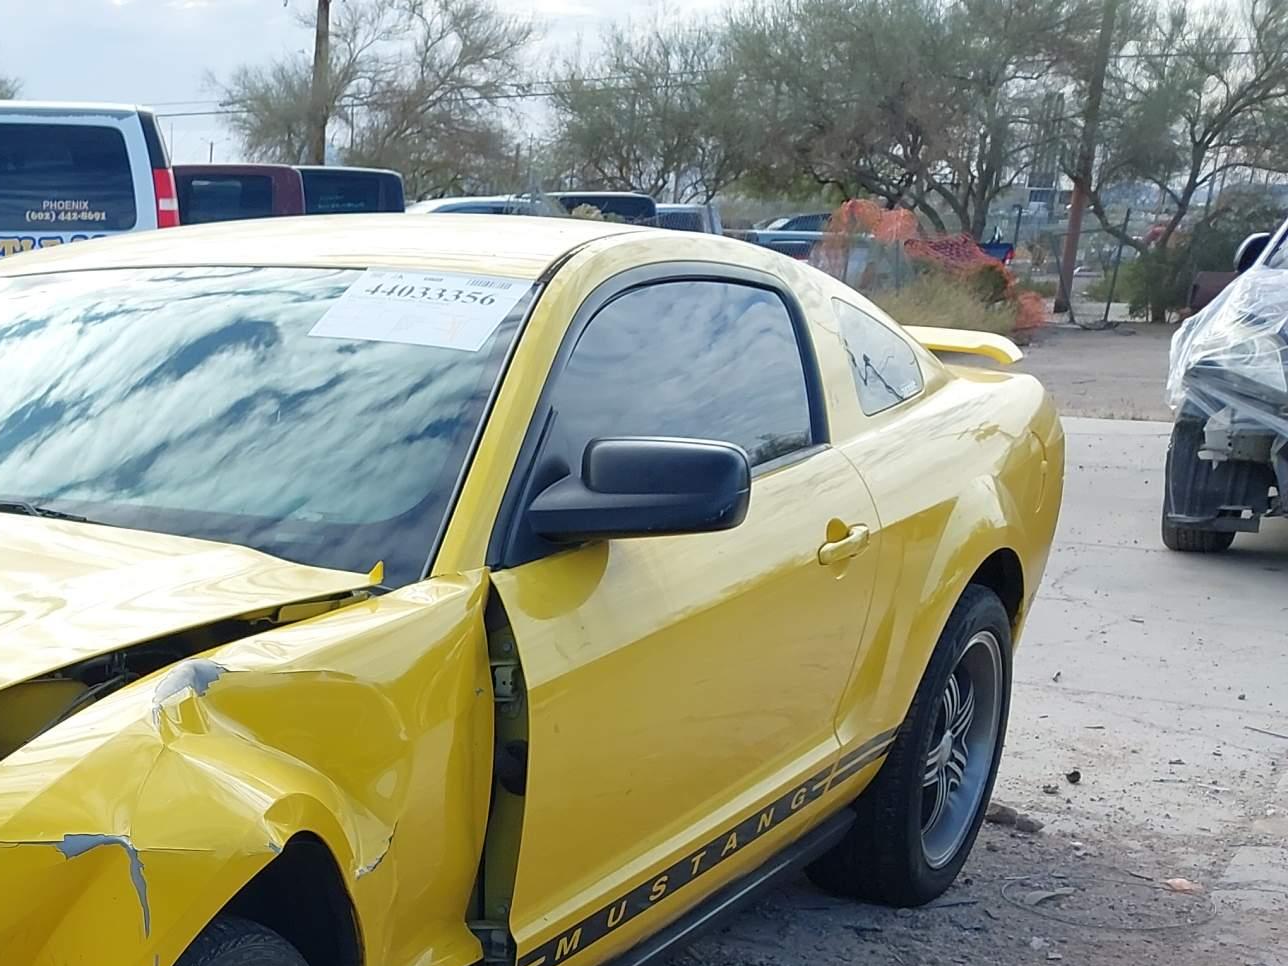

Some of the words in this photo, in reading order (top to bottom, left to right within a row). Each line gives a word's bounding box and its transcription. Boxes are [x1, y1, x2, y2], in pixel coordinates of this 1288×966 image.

[42, 199, 89, 210] PHOENIX
[25, 210, 56, 223] (602)
[364, 283, 496, 306] 44033356
[554, 788, 808, 962] MUSTANG
